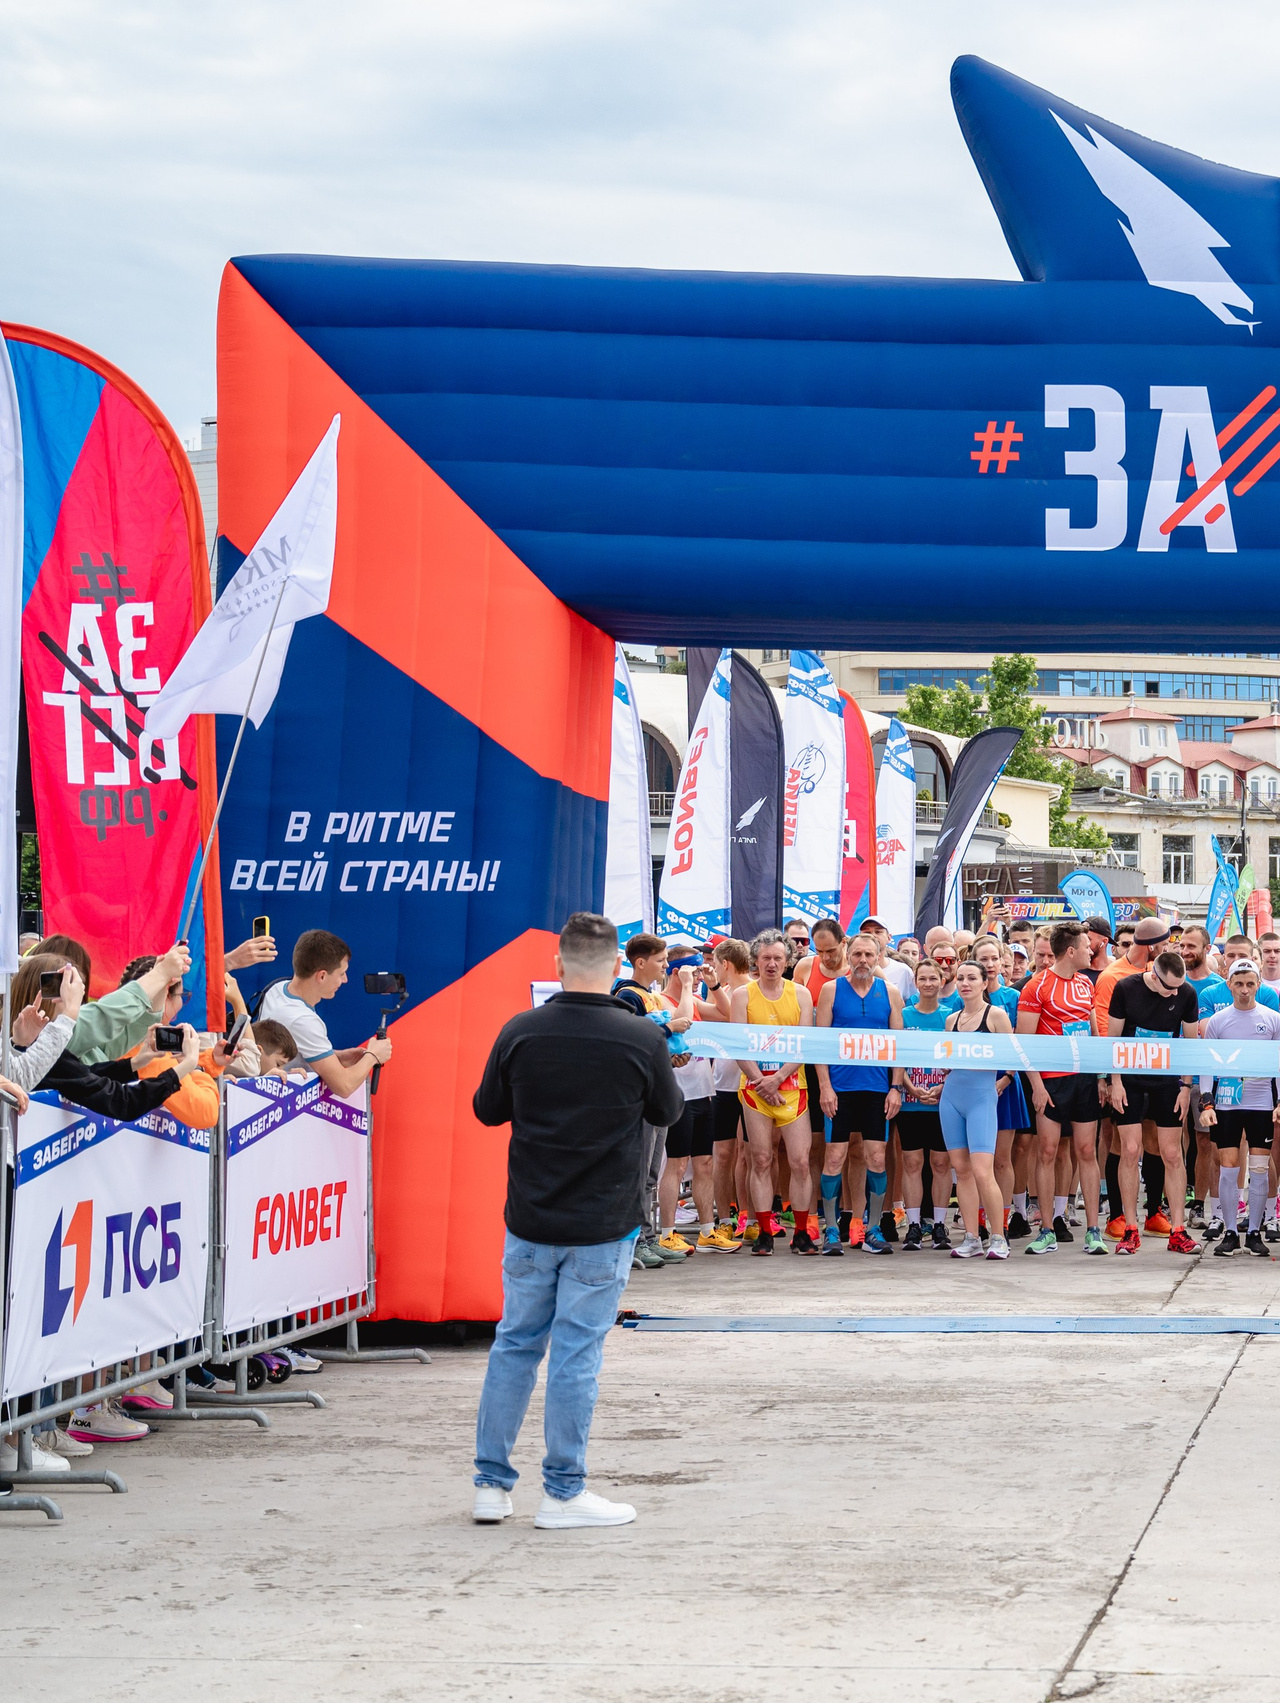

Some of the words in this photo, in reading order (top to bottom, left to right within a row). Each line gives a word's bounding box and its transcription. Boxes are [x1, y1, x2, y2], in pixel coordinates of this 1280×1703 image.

[284, 811, 311, 842] В
[322, 811, 455, 843] РИТМЕ
[229, 851, 329, 891] ВСЕЙ
[339, 860, 501, 892] СТРАНЫ!
[839, 1033, 896, 1060] СТАРТ
[957, 1044, 994, 1058] ПСБ
[1113, 1042, 1170, 1069] СТАРТ
[239, 1107, 283, 1145] ЗАБЕГ.РФ
[33, 1121, 97, 1170] ЗАБЕГ.РФ
[252, 1180, 347, 1260] FONBET
[103, 1201, 182, 1300] ПСБ
[71, 1418, 91, 1428] HOKA
